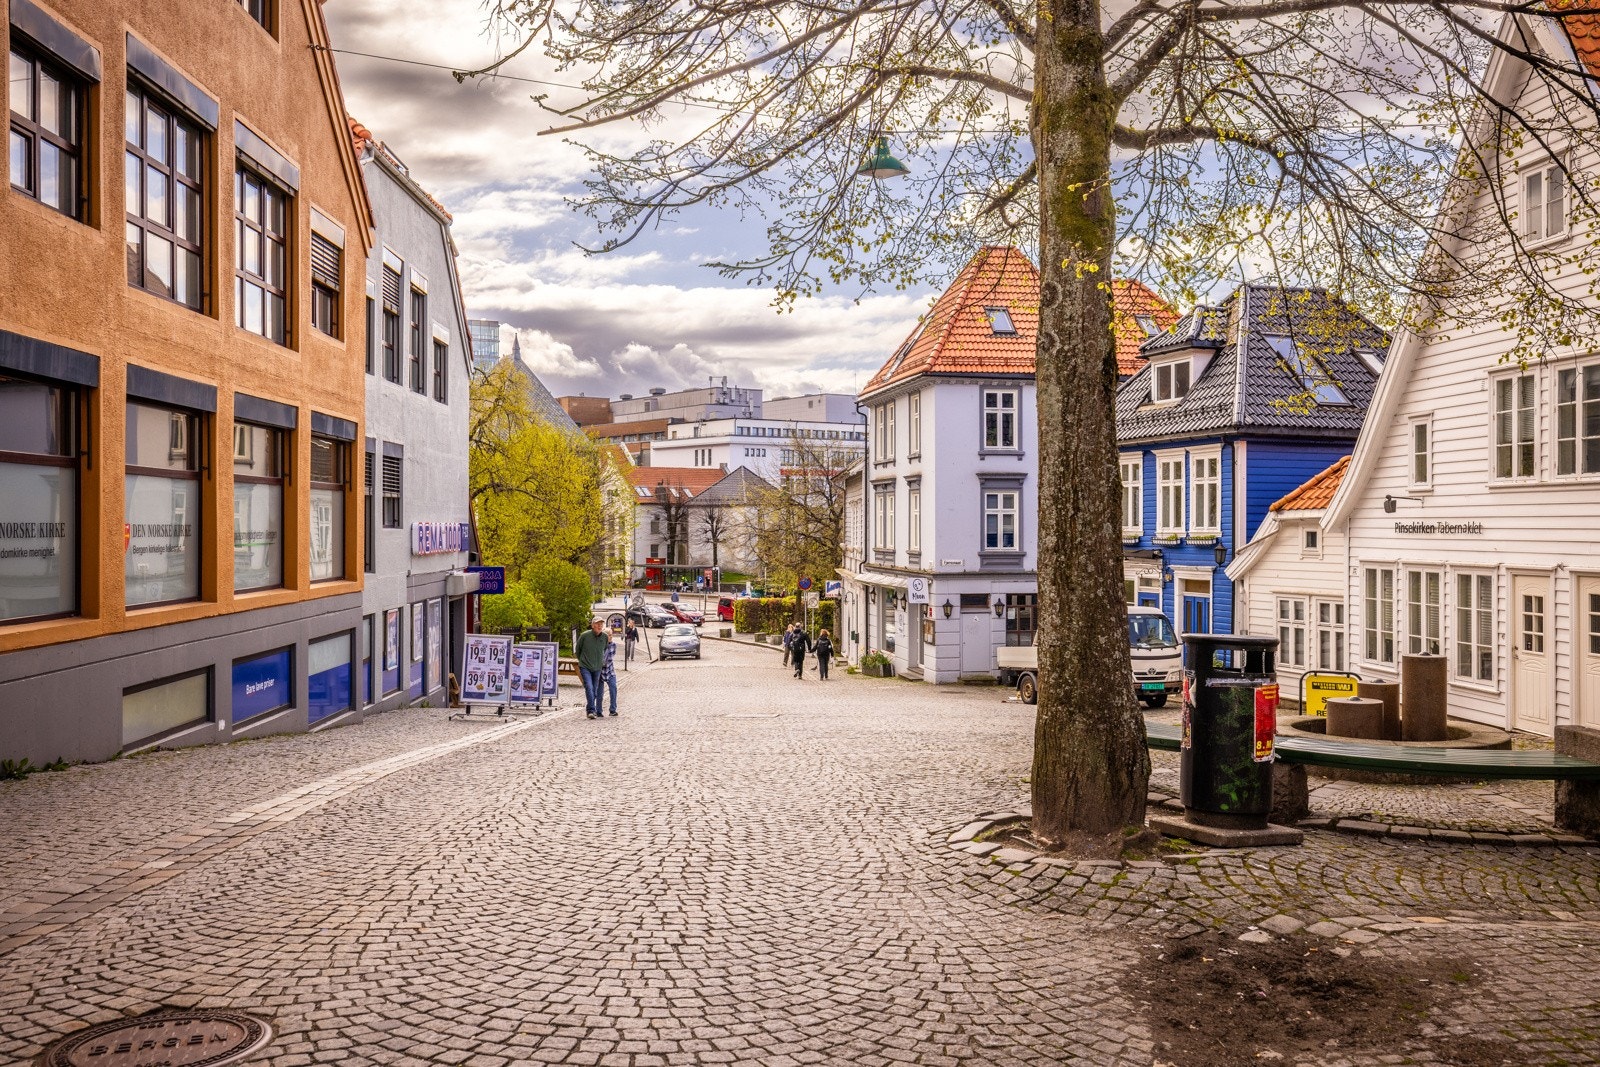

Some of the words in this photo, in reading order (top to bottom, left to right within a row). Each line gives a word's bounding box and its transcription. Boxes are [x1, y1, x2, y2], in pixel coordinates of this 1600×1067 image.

[0, 522, 36, 539] NORSKE
[39, 522, 66, 538] KIRKE
[132, 524, 146, 538] DEN
[148, 524, 172, 537] NORSKE
[173, 524, 192, 537] KIRKE
[1394, 522, 1435, 534] Pinsekirken
[1437, 521, 1483, 534] Tabernaklet
[418, 522, 443, 555] REMA
[445, 522, 462, 552] 1000
[132, 545, 148, 556] Bergen
[479, 571, 501, 580] EMA
[470, 646, 480, 660] 19
[489, 647, 499, 661] 19
[467, 673, 479, 686] 39
[487, 674, 497, 688] 19
[246, 684, 255, 695] Bare
[88, 1033, 228, 1057] BERGEN
